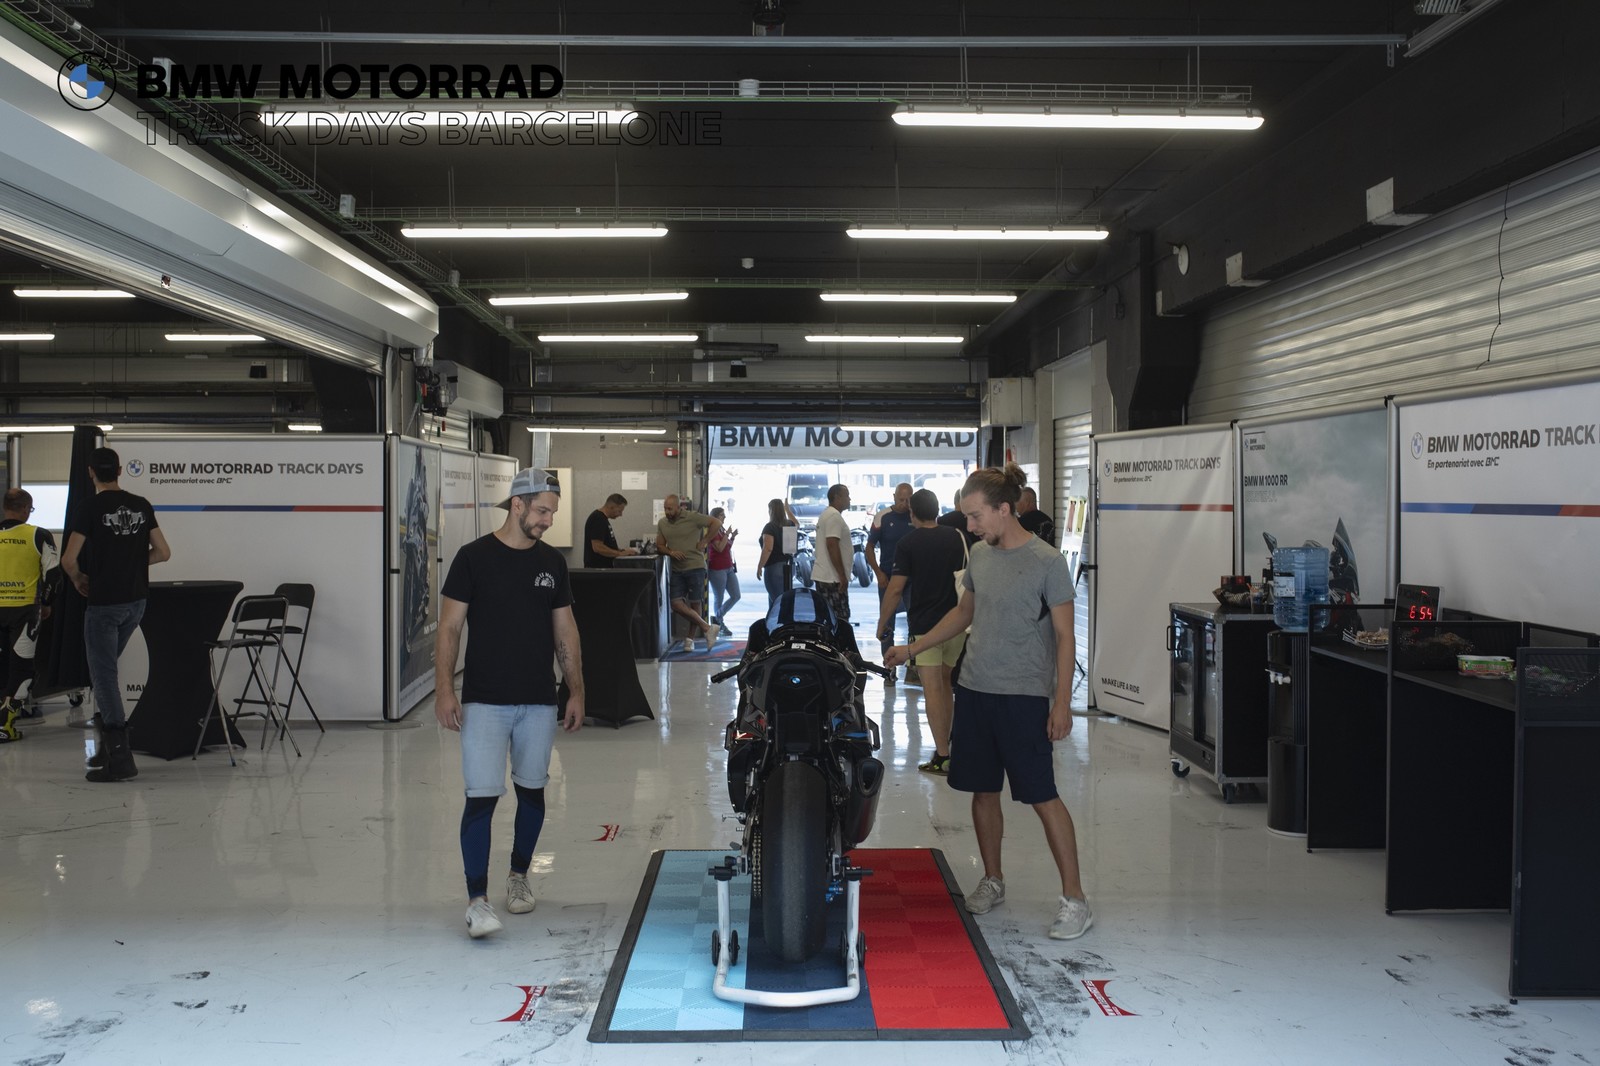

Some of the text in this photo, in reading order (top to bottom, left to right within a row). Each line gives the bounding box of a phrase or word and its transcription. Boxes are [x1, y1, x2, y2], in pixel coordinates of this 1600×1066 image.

[719, 426, 974, 447] BMW MOTORRAD
[1427, 424, 1596, 453] BMW MOTORRAD TRACK
[149, 463, 364, 474] BMW MOTORRAD TRACK DAYS
[1113, 457, 1221, 473] BMW MOTORRAD TRACK DAYS
[1427, 459, 1435, 469] En
[1435, 458, 1470, 470] partenariat
[1470, 459, 1484, 468] avec
[159, 477, 198, 485] partenariat
[1244, 474, 1289, 487] BMW M 1000 RR
[126, 684, 145, 692] MA
[1101, 677, 1117, 688] MAKE
